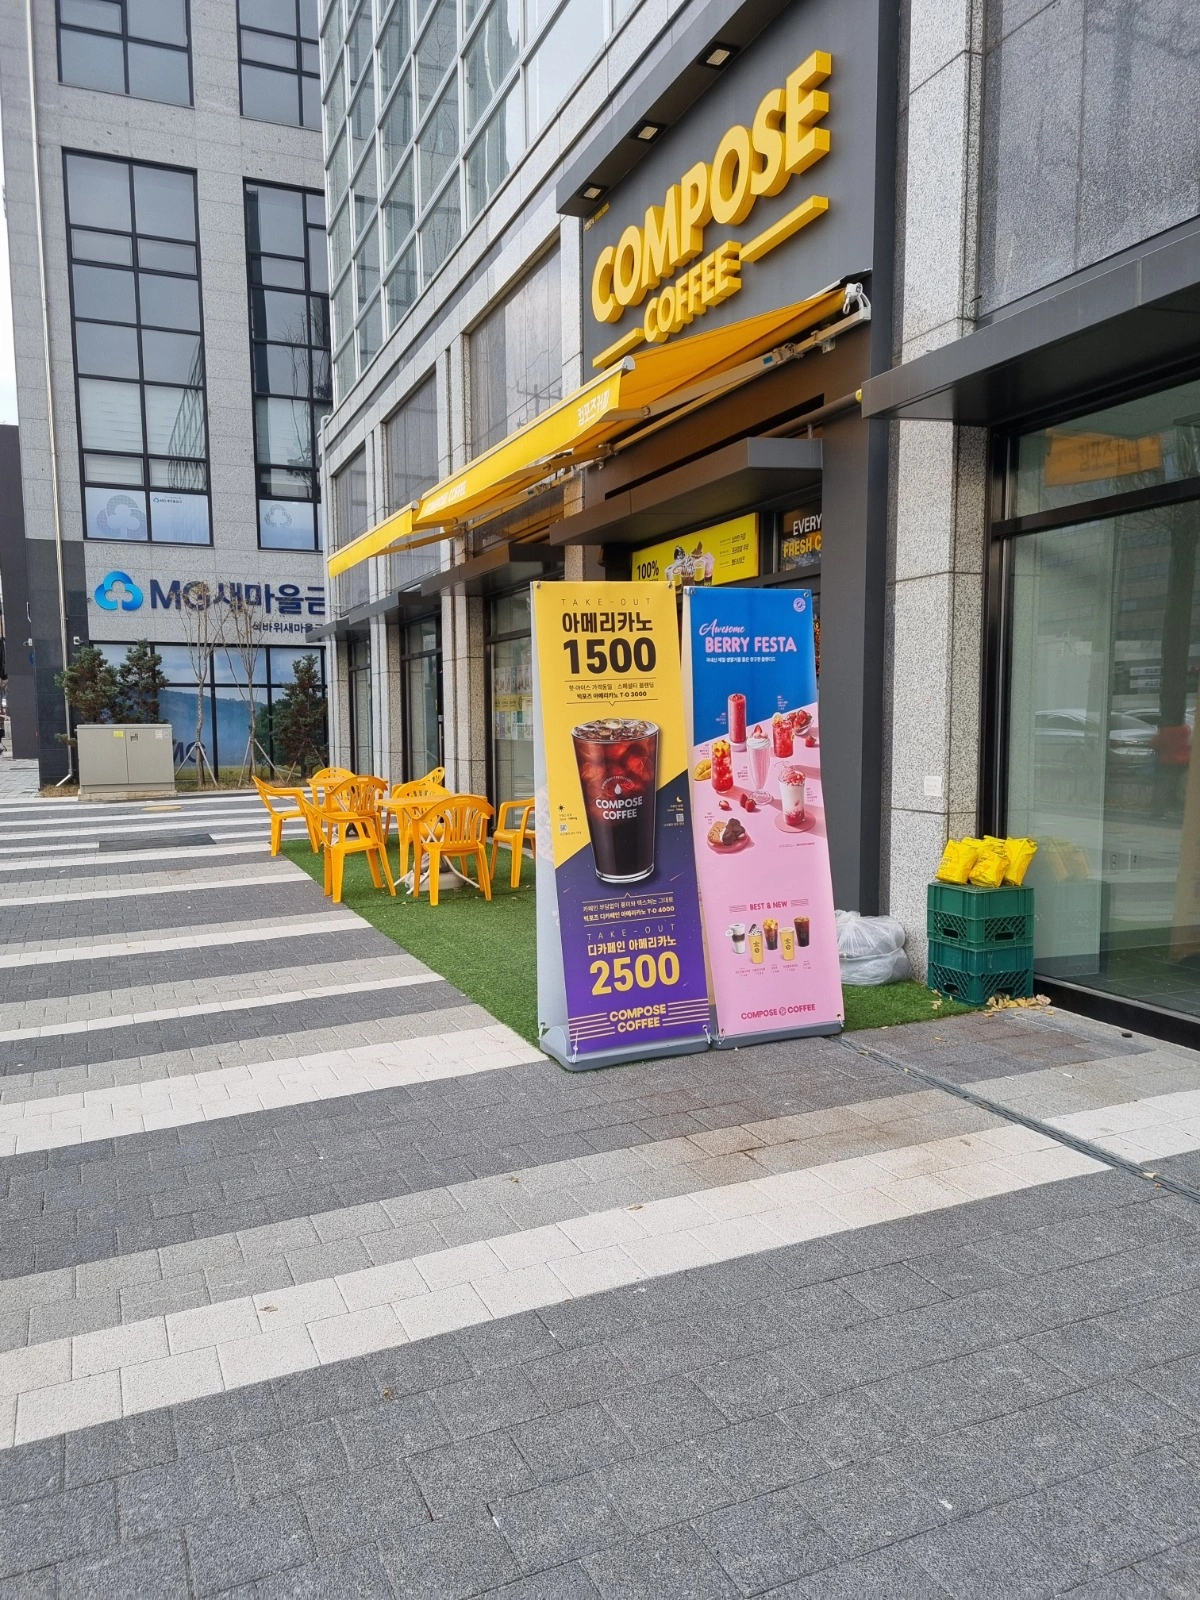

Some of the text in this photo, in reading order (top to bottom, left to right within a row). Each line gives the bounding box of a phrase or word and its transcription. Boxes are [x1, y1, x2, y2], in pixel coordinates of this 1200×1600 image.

[591, 50, 832, 323] COMPOSE
[644, 240, 742, 342] COFFEE
[783, 537, 812, 558] FRESH
[636, 559, 660, 581] 100%
[561, 598, 651, 606] TAKE-OUT
[562, 611, 653, 633] 아메리카노
[699, 618, 745, 636] Awesome
[705, 636, 797, 653] BERRY FESTA
[563, 637, 657, 675] 1500
[595, 795, 643, 809] COMPOSE
[602, 809, 637, 820] COFFEE
[749, 902, 764, 911] BEST
[586, 923, 675, 940] TAKE-OUT
[587, 935, 677, 956] 디카페인 아메리카노
[589, 951, 680, 996] 2500
[609, 1004, 667, 1022] COMPOSE
[741, 1004, 815, 1020] COMPOSE COFFEE
[617, 1017, 661, 1033] COFFEE
